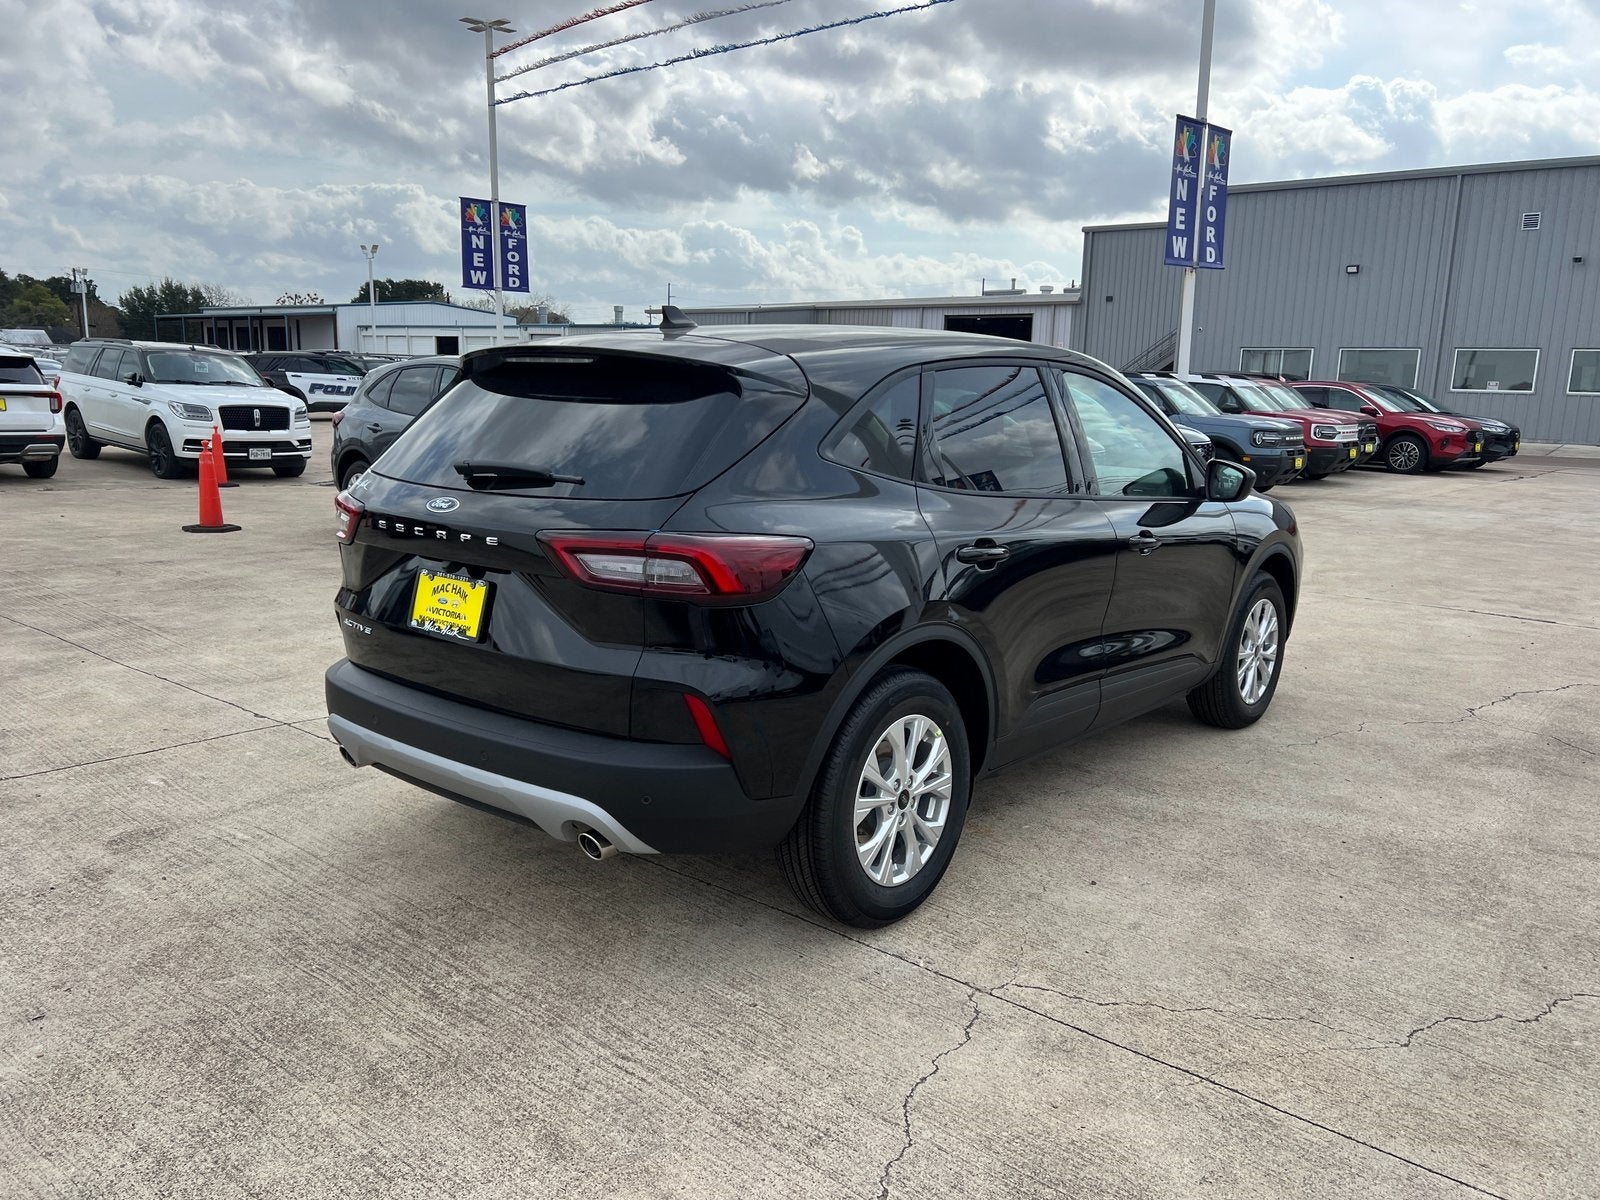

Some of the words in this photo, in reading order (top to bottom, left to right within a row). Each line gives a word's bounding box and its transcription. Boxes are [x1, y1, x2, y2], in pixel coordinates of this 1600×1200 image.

[1172, 177, 1188, 259] NEW
[1206, 185, 1218, 263] FORD
[470, 234, 487, 285] NEW
[507, 238, 520, 288] FORD
[378, 520, 499, 546] ESCAPE
[432, 583, 451, 596] MAC
[451, 583, 468, 604] HAIK
[343, 618, 372, 634] ACTIVE
[431, 606, 462, 620] VICTORIA
